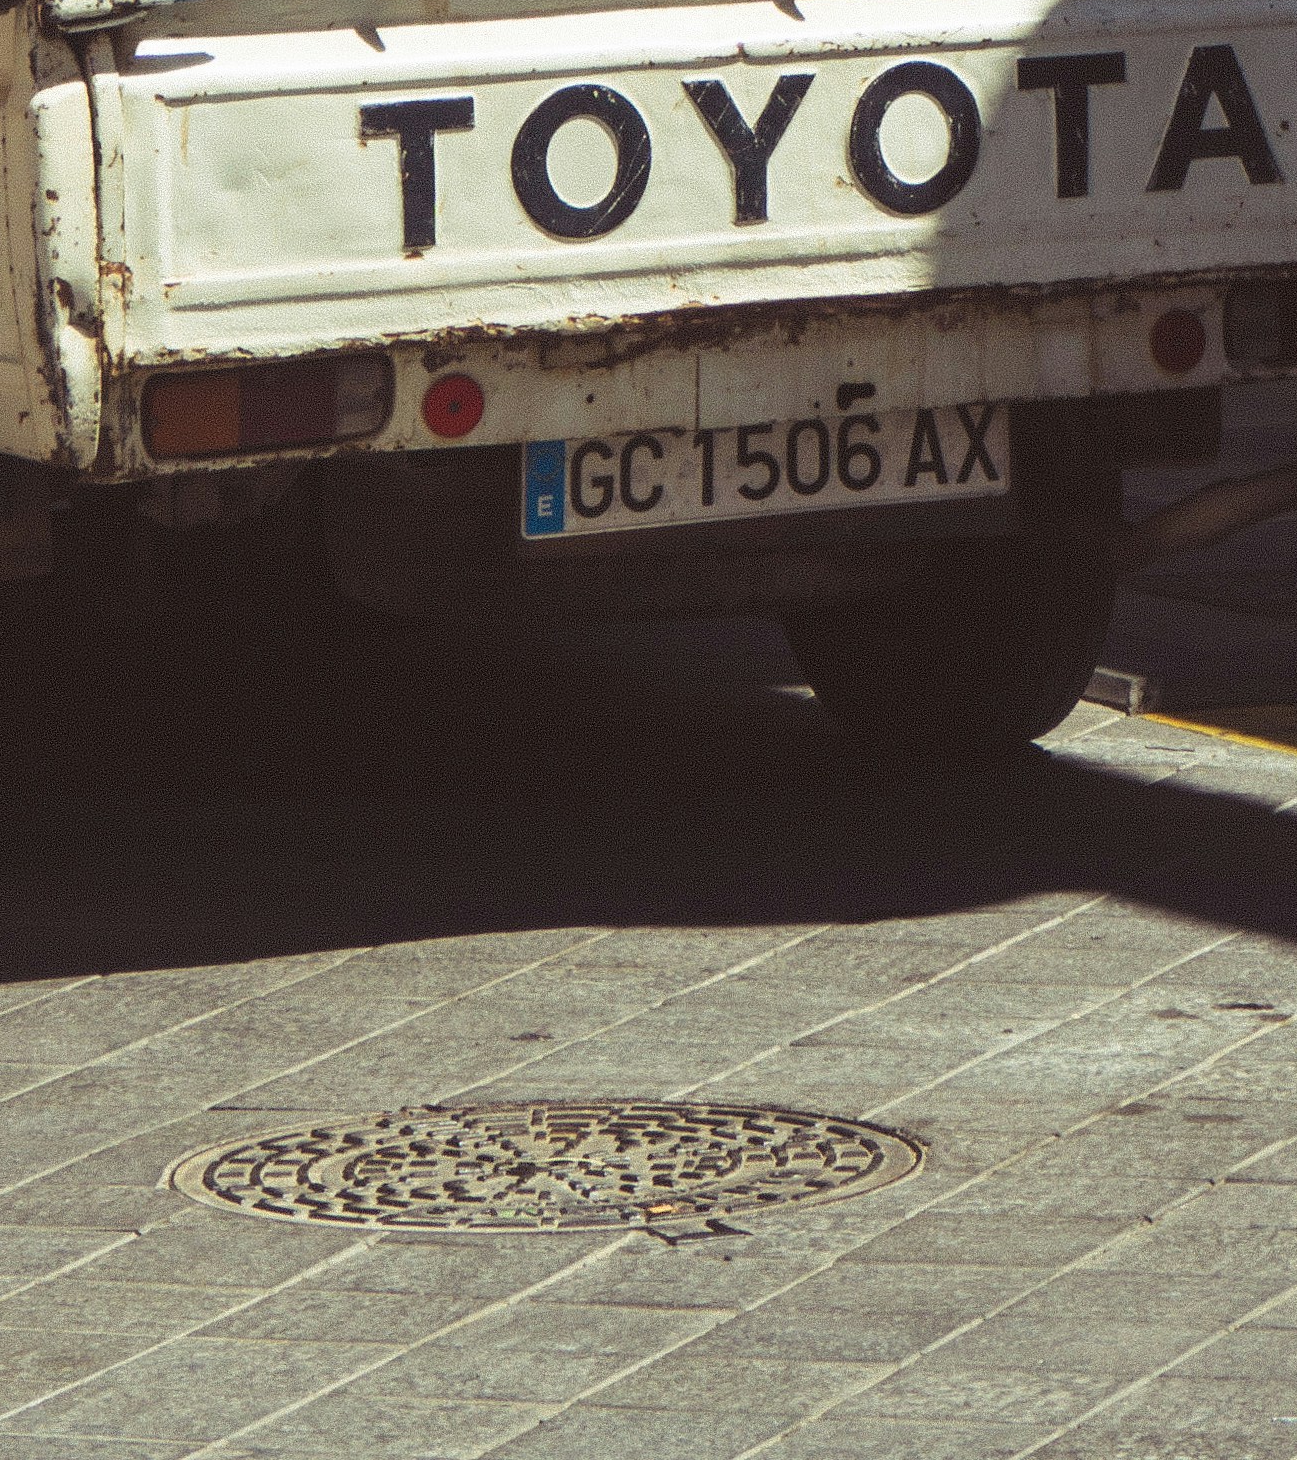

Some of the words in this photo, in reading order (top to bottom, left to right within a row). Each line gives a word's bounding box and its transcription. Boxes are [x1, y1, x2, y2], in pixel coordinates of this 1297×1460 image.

[358, 42, 1287, 251] TOYOTA
[536, 495, 554, 518] E
[569, 432, 665, 520] GC
[693, 413, 883, 507] 1506
[903, 403, 1001, 489] AX
